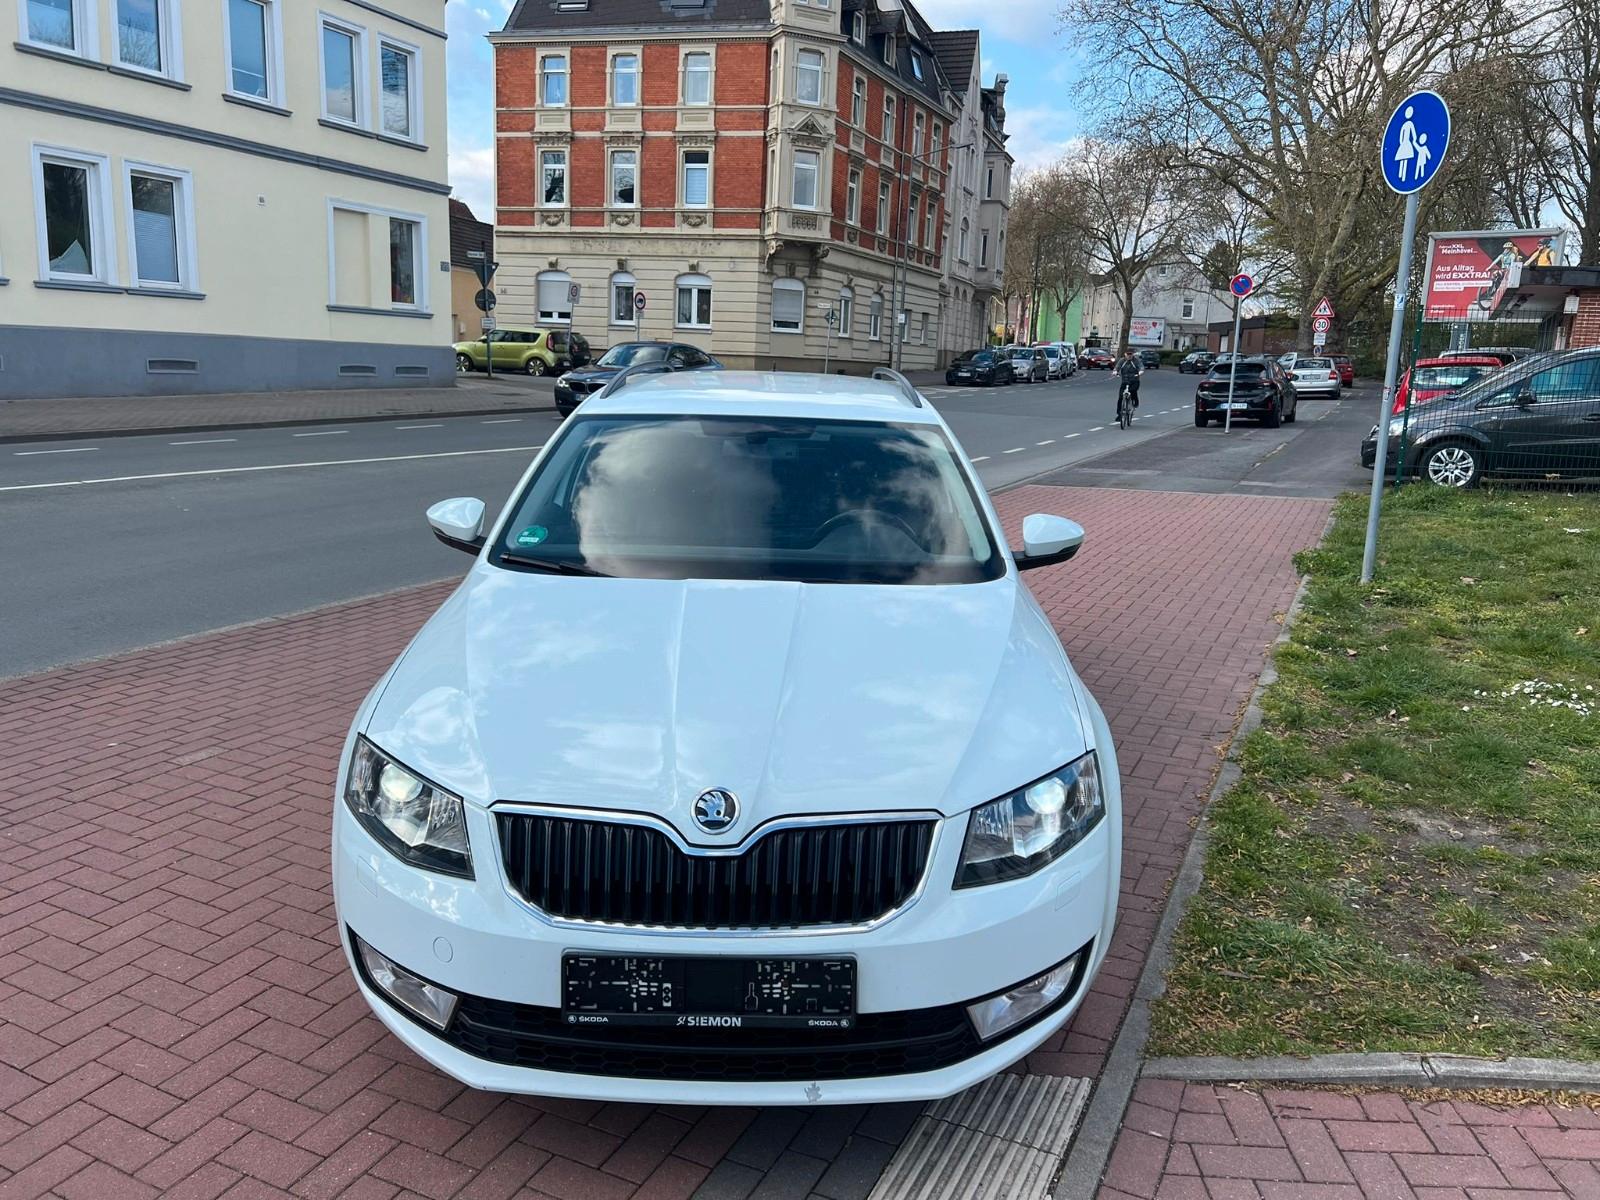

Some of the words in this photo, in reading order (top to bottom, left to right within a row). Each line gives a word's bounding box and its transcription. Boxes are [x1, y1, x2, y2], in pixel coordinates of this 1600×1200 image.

[1452, 264, 1474, 273] Alltag
[1452, 271, 1491, 279] EXXTRA!
[1316, 321, 1326, 329] 30
[578, 1015, 609, 1023] ŠKODA
